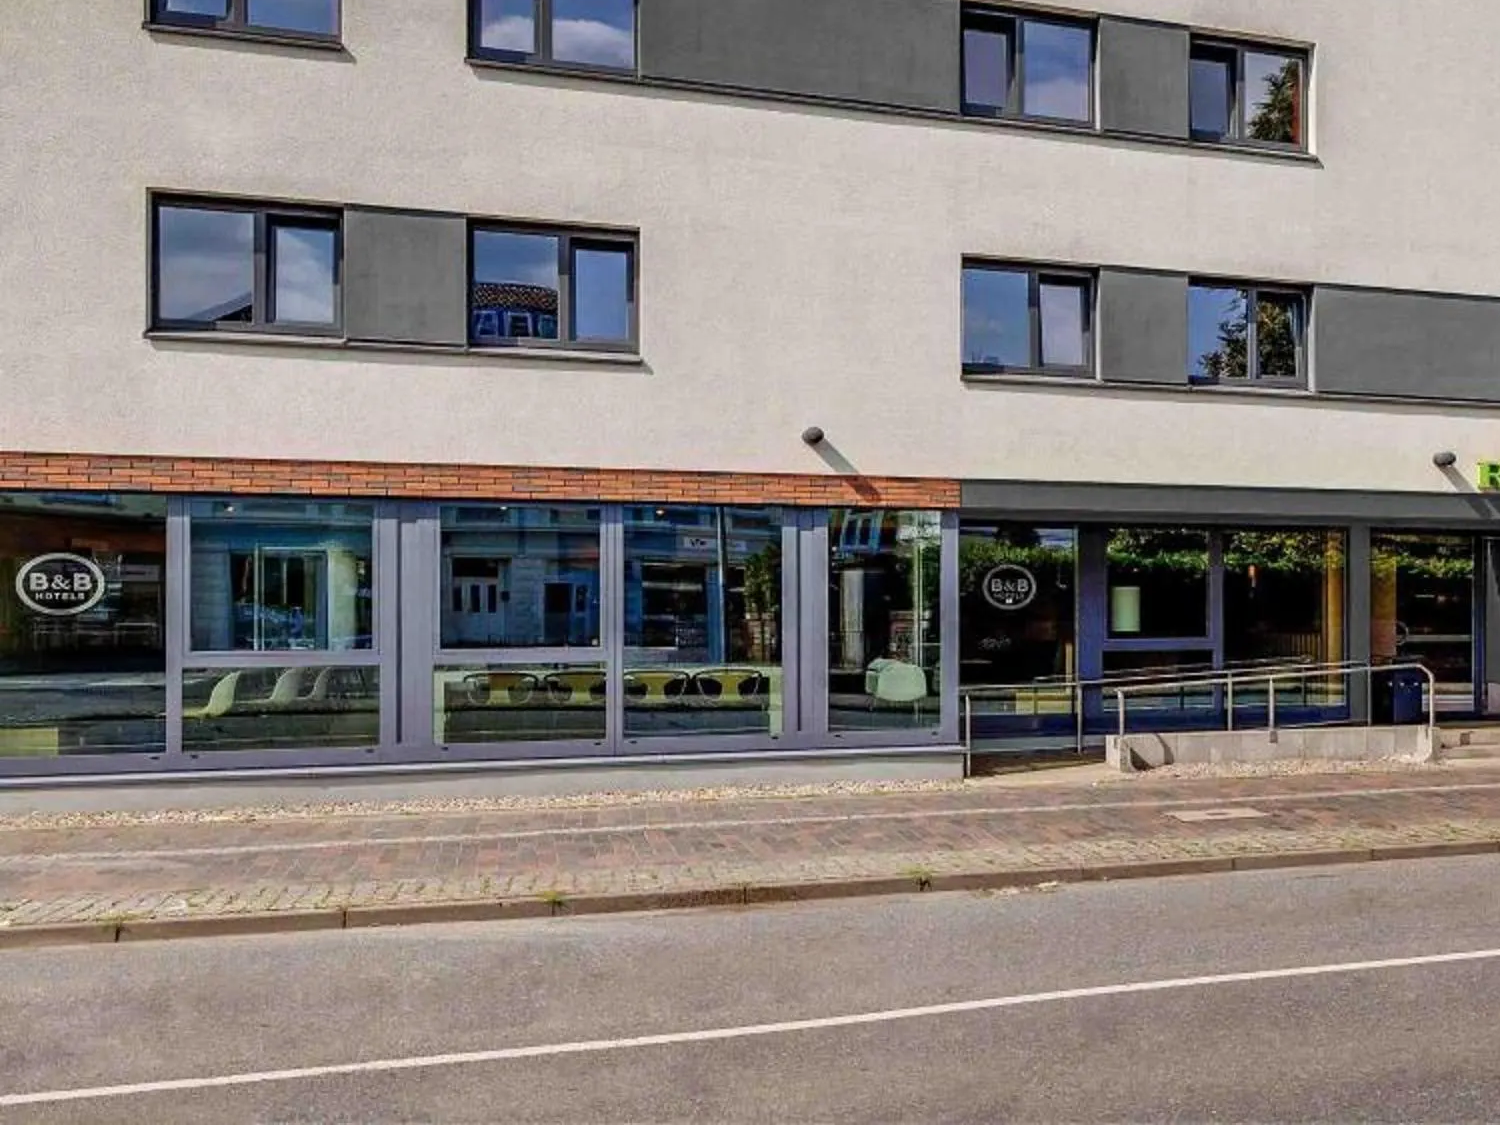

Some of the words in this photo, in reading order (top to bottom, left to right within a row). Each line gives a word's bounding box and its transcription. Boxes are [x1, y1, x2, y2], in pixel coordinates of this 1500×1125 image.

[29, 572, 92, 592] B&B
[991, 578, 1029, 592] B&B
[35, 592, 85, 601] HOTELS
